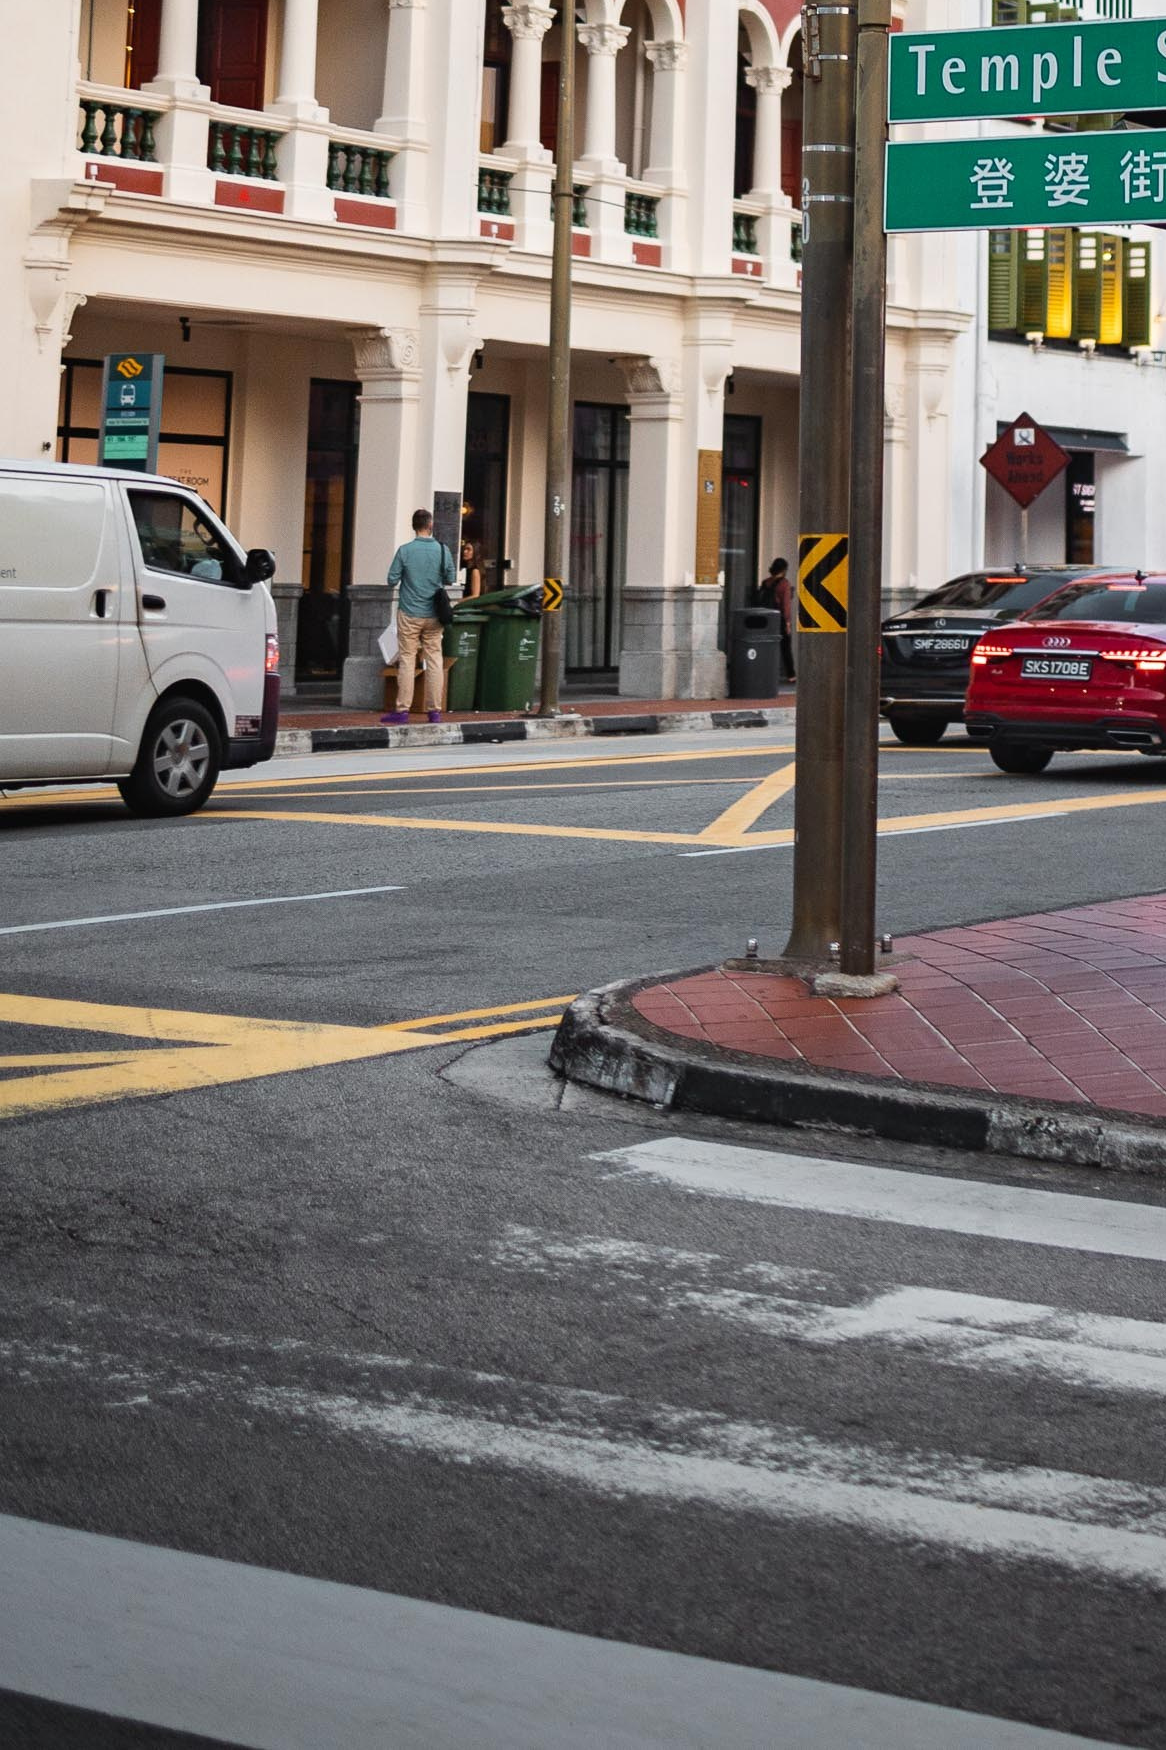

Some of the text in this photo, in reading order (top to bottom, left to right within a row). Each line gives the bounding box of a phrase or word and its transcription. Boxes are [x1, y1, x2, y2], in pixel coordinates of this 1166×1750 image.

[908, 35, 1122, 104] Temple
[1006, 451, 1044, 466] Works
[187, 477, 209, 487] ROOM
[1007, 469, 1044, 484] Ahead
[1024, 659, 1089, 676] SKS1708E
